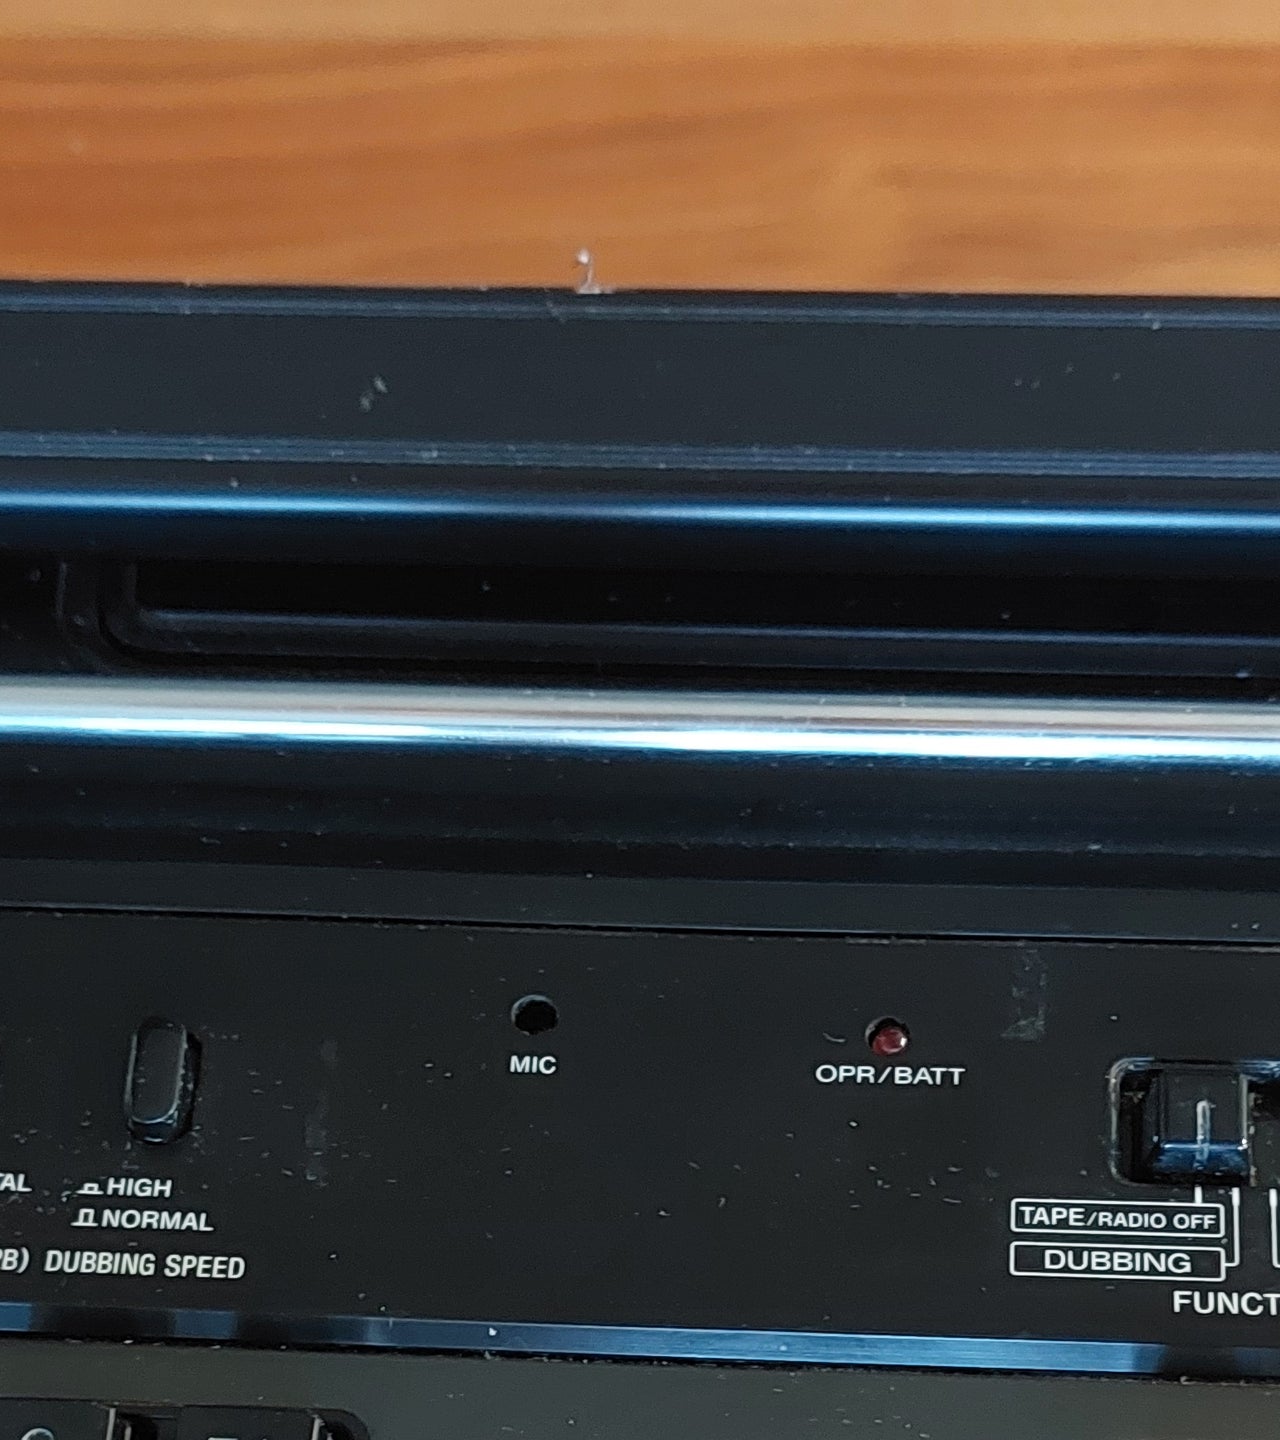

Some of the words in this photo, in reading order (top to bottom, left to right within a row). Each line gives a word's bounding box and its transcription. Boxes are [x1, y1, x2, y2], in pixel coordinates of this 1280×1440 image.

[509, 1056, 557, 1075] MIC
[815, 1065, 966, 1086] OPR/BATT
[106, 1178, 172, 1198] HIGH
[101, 1211, 214, 1232] NORMAL
[1020, 1206, 1167, 1228] TAPE/RADIO
[1173, 1213, 1216, 1230] OFF
[44, 1250, 156, 1276] DUBBING
[163, 1254, 246, 1280] SPEED
[1044, 1250, 1192, 1273] DUBBING
